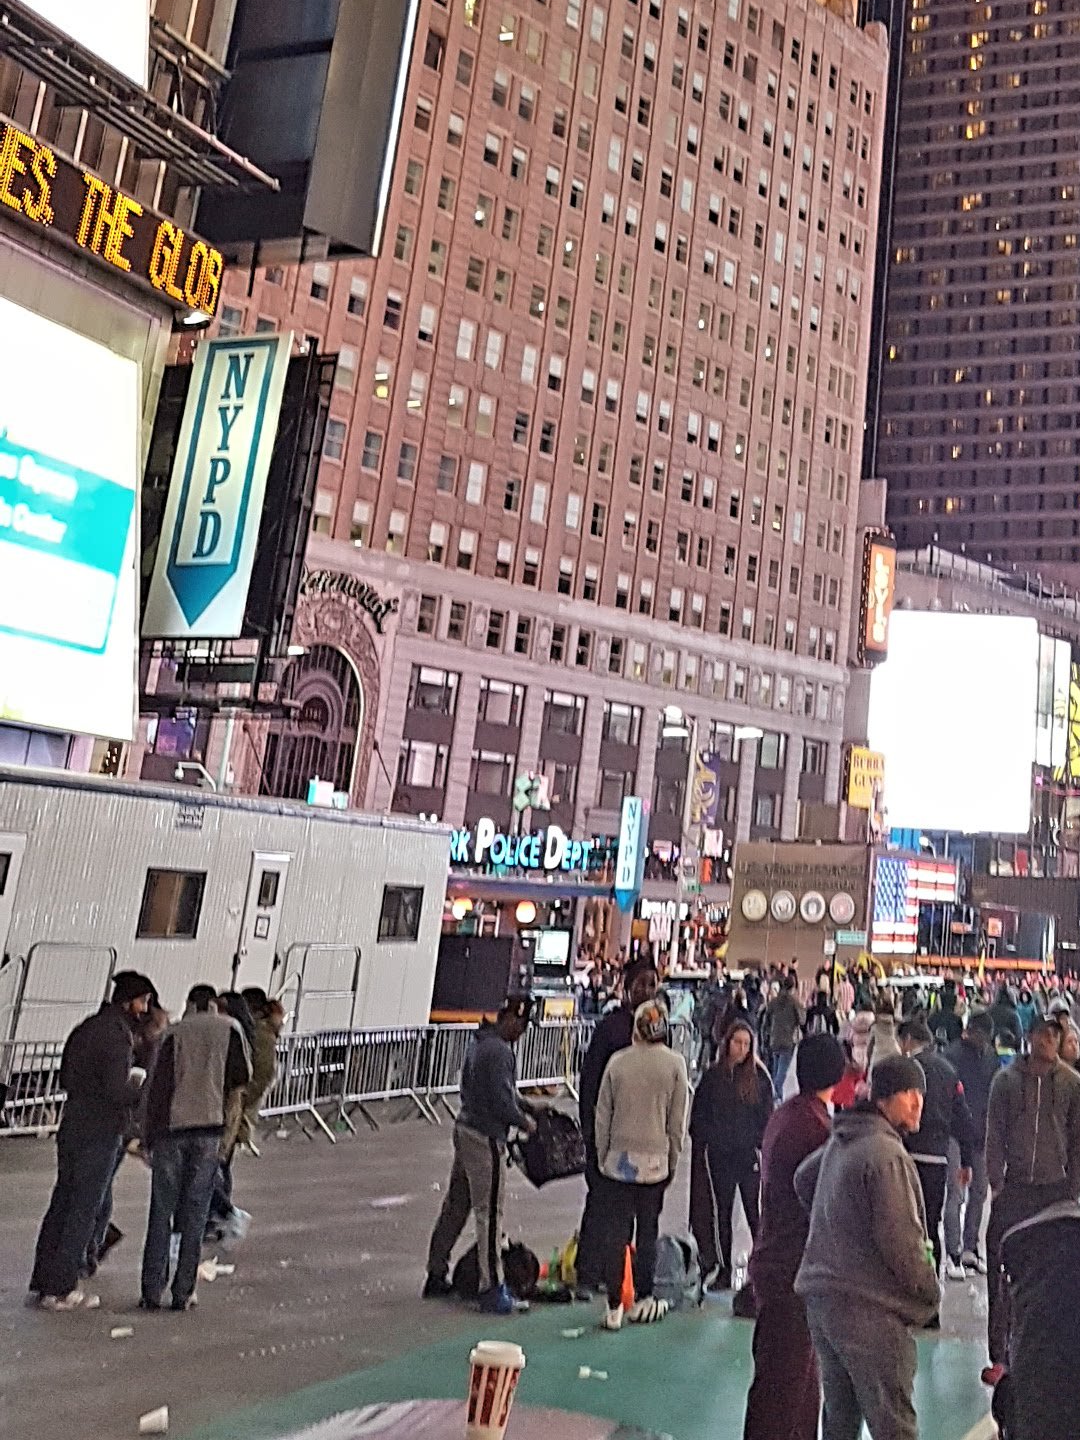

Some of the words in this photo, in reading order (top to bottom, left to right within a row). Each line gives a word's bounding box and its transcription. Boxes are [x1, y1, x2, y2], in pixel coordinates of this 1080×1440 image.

[0, 120, 58, 228] ES
[75, 168, 144, 273] THE
[191, 352, 255, 559] NYPD
[474, 817, 541, 868] POLICE
[544, 824, 595, 872] DEPT
[621, 802, 639, 883] NYPD
